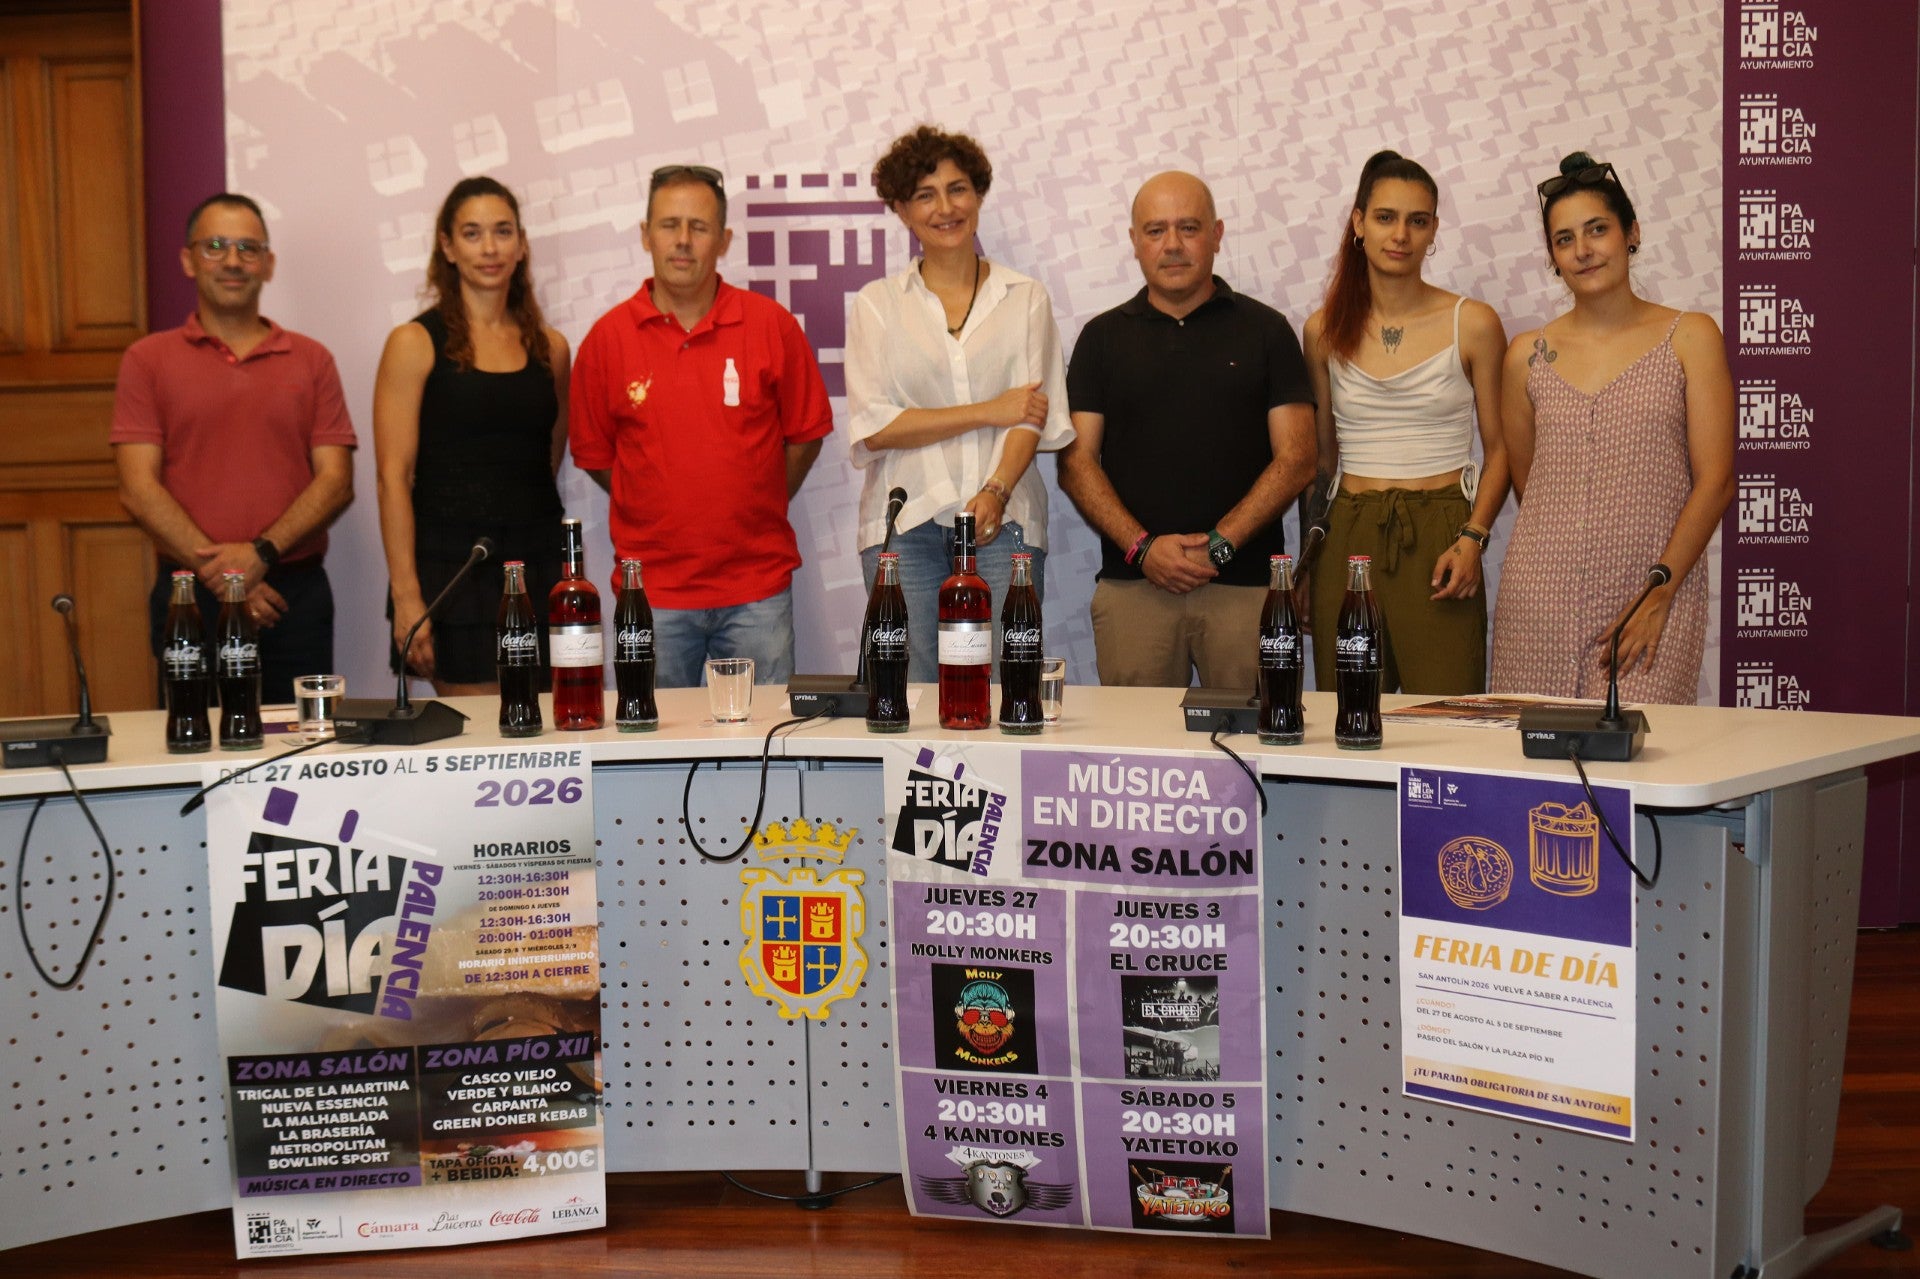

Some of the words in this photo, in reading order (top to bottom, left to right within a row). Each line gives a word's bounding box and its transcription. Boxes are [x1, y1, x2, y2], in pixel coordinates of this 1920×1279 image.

[1783, 12, 1806, 25] PA
[1783, 27, 1817, 41] LEN
[1783, 42, 1813, 57] CIA
[1740, 61, 1813, 69] AYUNTAMIENTO
[1783, 109, 1804, 122] PA
[1782, 124, 1816, 137] LEN
[1781, 139, 1811, 153] CIA
[1739, 157, 1812, 165] AYUNTAMIENTO
[1781, 204, 1803, 217] PA
[1781, 219, 1814, 233] LEN
[1781, 235, 1810, 248] CIA
[1739, 252, 1811, 260] AYUNTAMIENTO
[1781, 299, 1803, 312] PA
[1781, 314, 1814, 328] LEN
[1781, 329, 1810, 343] CIA
[1739, 347, 1811, 355] AYUNTAMIENTO
[1781, 394, 1802, 407] PA
[1781, 409, 1813, 422] LEN
[1780, 424, 1809, 438] CIA
[1739, 442, 1810, 450] AYUNTAMIENTO
[1780, 488, 1801, 501] PA
[1780, 503, 1812, 517] LEN
[1779, 518, 1808, 532] CIA
[1738, 536, 1809, 544] AYUNTAMIENTO
[1779, 582, 1800, 595] PA
[1779, 597, 1811, 610] LEN
[1778, 612, 1807, 625] CIA
[1005, 629, 1039, 643] Coca-Cola
[1260, 635, 1296, 649] Coca-Cola
[1737, 630, 1808, 638] AYUNTAMIENTO
[1778, 676, 1799, 689] PA
[1777, 690, 1810, 703] LEN
[265, 765, 291, 782] 27
[299, 759, 388, 780] AGOSTO
[395, 758, 418, 775] AL
[426, 758, 438, 772] 5
[446, 751, 581, 771] SEPTIEMBRE
[1068, 757, 1210, 800] MÚSICA
[474, 777, 582, 808] 2026
[1033, 796, 1078, 827] EN
[1091, 799, 1247, 835] DIRECTO
[473, 840, 571, 857] HORARIOS
[1026, 840, 1121, 873] ZONA
[1130, 843, 1253, 876] SALÓN
[478, 871, 569, 885] 12:30H-16:30H
[479, 887, 569, 901] 20:00H-01:30H
[923, 887, 1005, 908] JUEVES
[1012, 891, 1038, 909] 27
[1113, 900, 1199, 919] JUEVES
[1206, 902, 1220, 918] 3
[480, 913, 570, 928] 12:30H-16:30H
[926, 910, 1036, 940] 20:30H
[380, 861, 443, 1021] PALENCIA
[530, 928, 572, 940] 01:00H
[1109, 923, 1226, 949] 20:30H
[459, 957, 505, 969] HORARIO
[508, 952, 594, 965] ININTERRUMPIDO
[911, 943, 965, 959] MOLLY
[970, 947, 1053, 965] MONKERS
[1413, 934, 1501, 971] FERIA
[1510, 948, 1554, 978] DE
[1559, 952, 1618, 988] DÍA
[1110, 953, 1140, 970] EL
[1145, 953, 1228, 972] CRUCE
[465, 974, 481, 983] DE
[486, 970, 528, 982] 12:30H
[532, 970, 540, 978] A
[544, 965, 590, 977] CIERRE
[1418, 972, 1434, 980] SAN
[1436, 974, 1470, 987] ANTOLÍN
[1471, 980, 1489, 989] 2026
[1493, 984, 1524, 995] VUELVE
[1534, 990, 1561, 1001] SABER
[1571, 996, 1613, 1009] PALENCIA
[1161, 1005, 1196, 1016] CRUCE
[1417, 1007, 1430, 1015] DEL
[1454, 1014, 1484, 1024] AGOSTO
[1515, 1024, 1563, 1038] SEPTIEMBRE
[425, 1048, 499, 1069] ZONA
[507, 1044, 550, 1062] PÍO
[555, 1036, 590, 1057] XII
[1417, 1033, 1441, 1042] PASEO
[1443, 1038, 1457, 1046] DEL
[1459, 1040, 1483, 1050] SALÓN
[1502, 1049, 1527, 1059] PLAZA
[1529, 1053, 1542, 1061] PÍO
[235, 1061, 312, 1081] ZONA
[319, 1050, 408, 1076] SALÓN
[461, 1072, 511, 1086] CASCO
[514, 1068, 556, 1082] VIEJO
[237, 1088, 291, 1101] TRIGAL
[294, 1086, 316, 1098] DE
[318, 1084, 338, 1096] LA
[340, 1080, 409, 1095] MARTINA
[447, 1088, 496, 1101] VERDE
[499, 1086, 509, 1097] Y
[512, 1081, 572, 1096] BLANCO
[933, 1079, 1029, 1098] VIERNES
[1035, 1084, 1048, 1099] 4
[1120, 1087, 1216, 1107] SÁBADO
[1222, 1093, 1235, 1107] 5
[1414, 1067, 1429, 1076] ¡TU
[1431, 1070, 1469, 1085] PARADA
[1470, 1078, 1534, 1098] OBLIGATORIA
[1537, 1090, 1550, 1101] DE
[1552, 1093, 1572, 1105] SAN
[1574, 1097, 1621, 1115] ANTOLÍN!
[261, 1101, 313, 1115] NUEVA
[317, 1096, 388, 1111] ESSENCIA
[472, 1098, 548, 1114] CARPANTA
[937, 1100, 1047, 1127] 20:30H
[263, 1116, 283, 1129] LA
[285, 1111, 389, 1127] MALHABLADA
[432, 1118, 482, 1131] GREEN
[486, 1113, 537, 1127] DONER
[540, 1107, 587, 1123] KEBAB
[1122, 1111, 1235, 1136] 20:30H
[279, 1129, 298, 1141] LA
[302, 1124, 375, 1140] BRASERÍA
[924, 1126, 937, 1139] 4
[944, 1128, 1065, 1147] KANTONES
[270, 1139, 386, 1156] METROPOLITAN
[1121, 1137, 1239, 1157] YATETOKO
[268, 1156, 336, 1171] BOWLING
[340, 1152, 390, 1165] SPORT
[429, 1157, 461, 1170] TAPA
[465, 1154, 518, 1167] OFICIAL
[522, 1150, 594, 1177] 4,00€
[246, 1176, 310, 1194] MÚSICA
[315, 1176, 336, 1190] EN
[340, 1172, 410, 1188] DIRECTO
[447, 1167, 519, 1183] BEBIDA:
[552, 1206, 599, 1219] LEBANZA
[1138, 1196, 1231, 1217] YATETOKO
